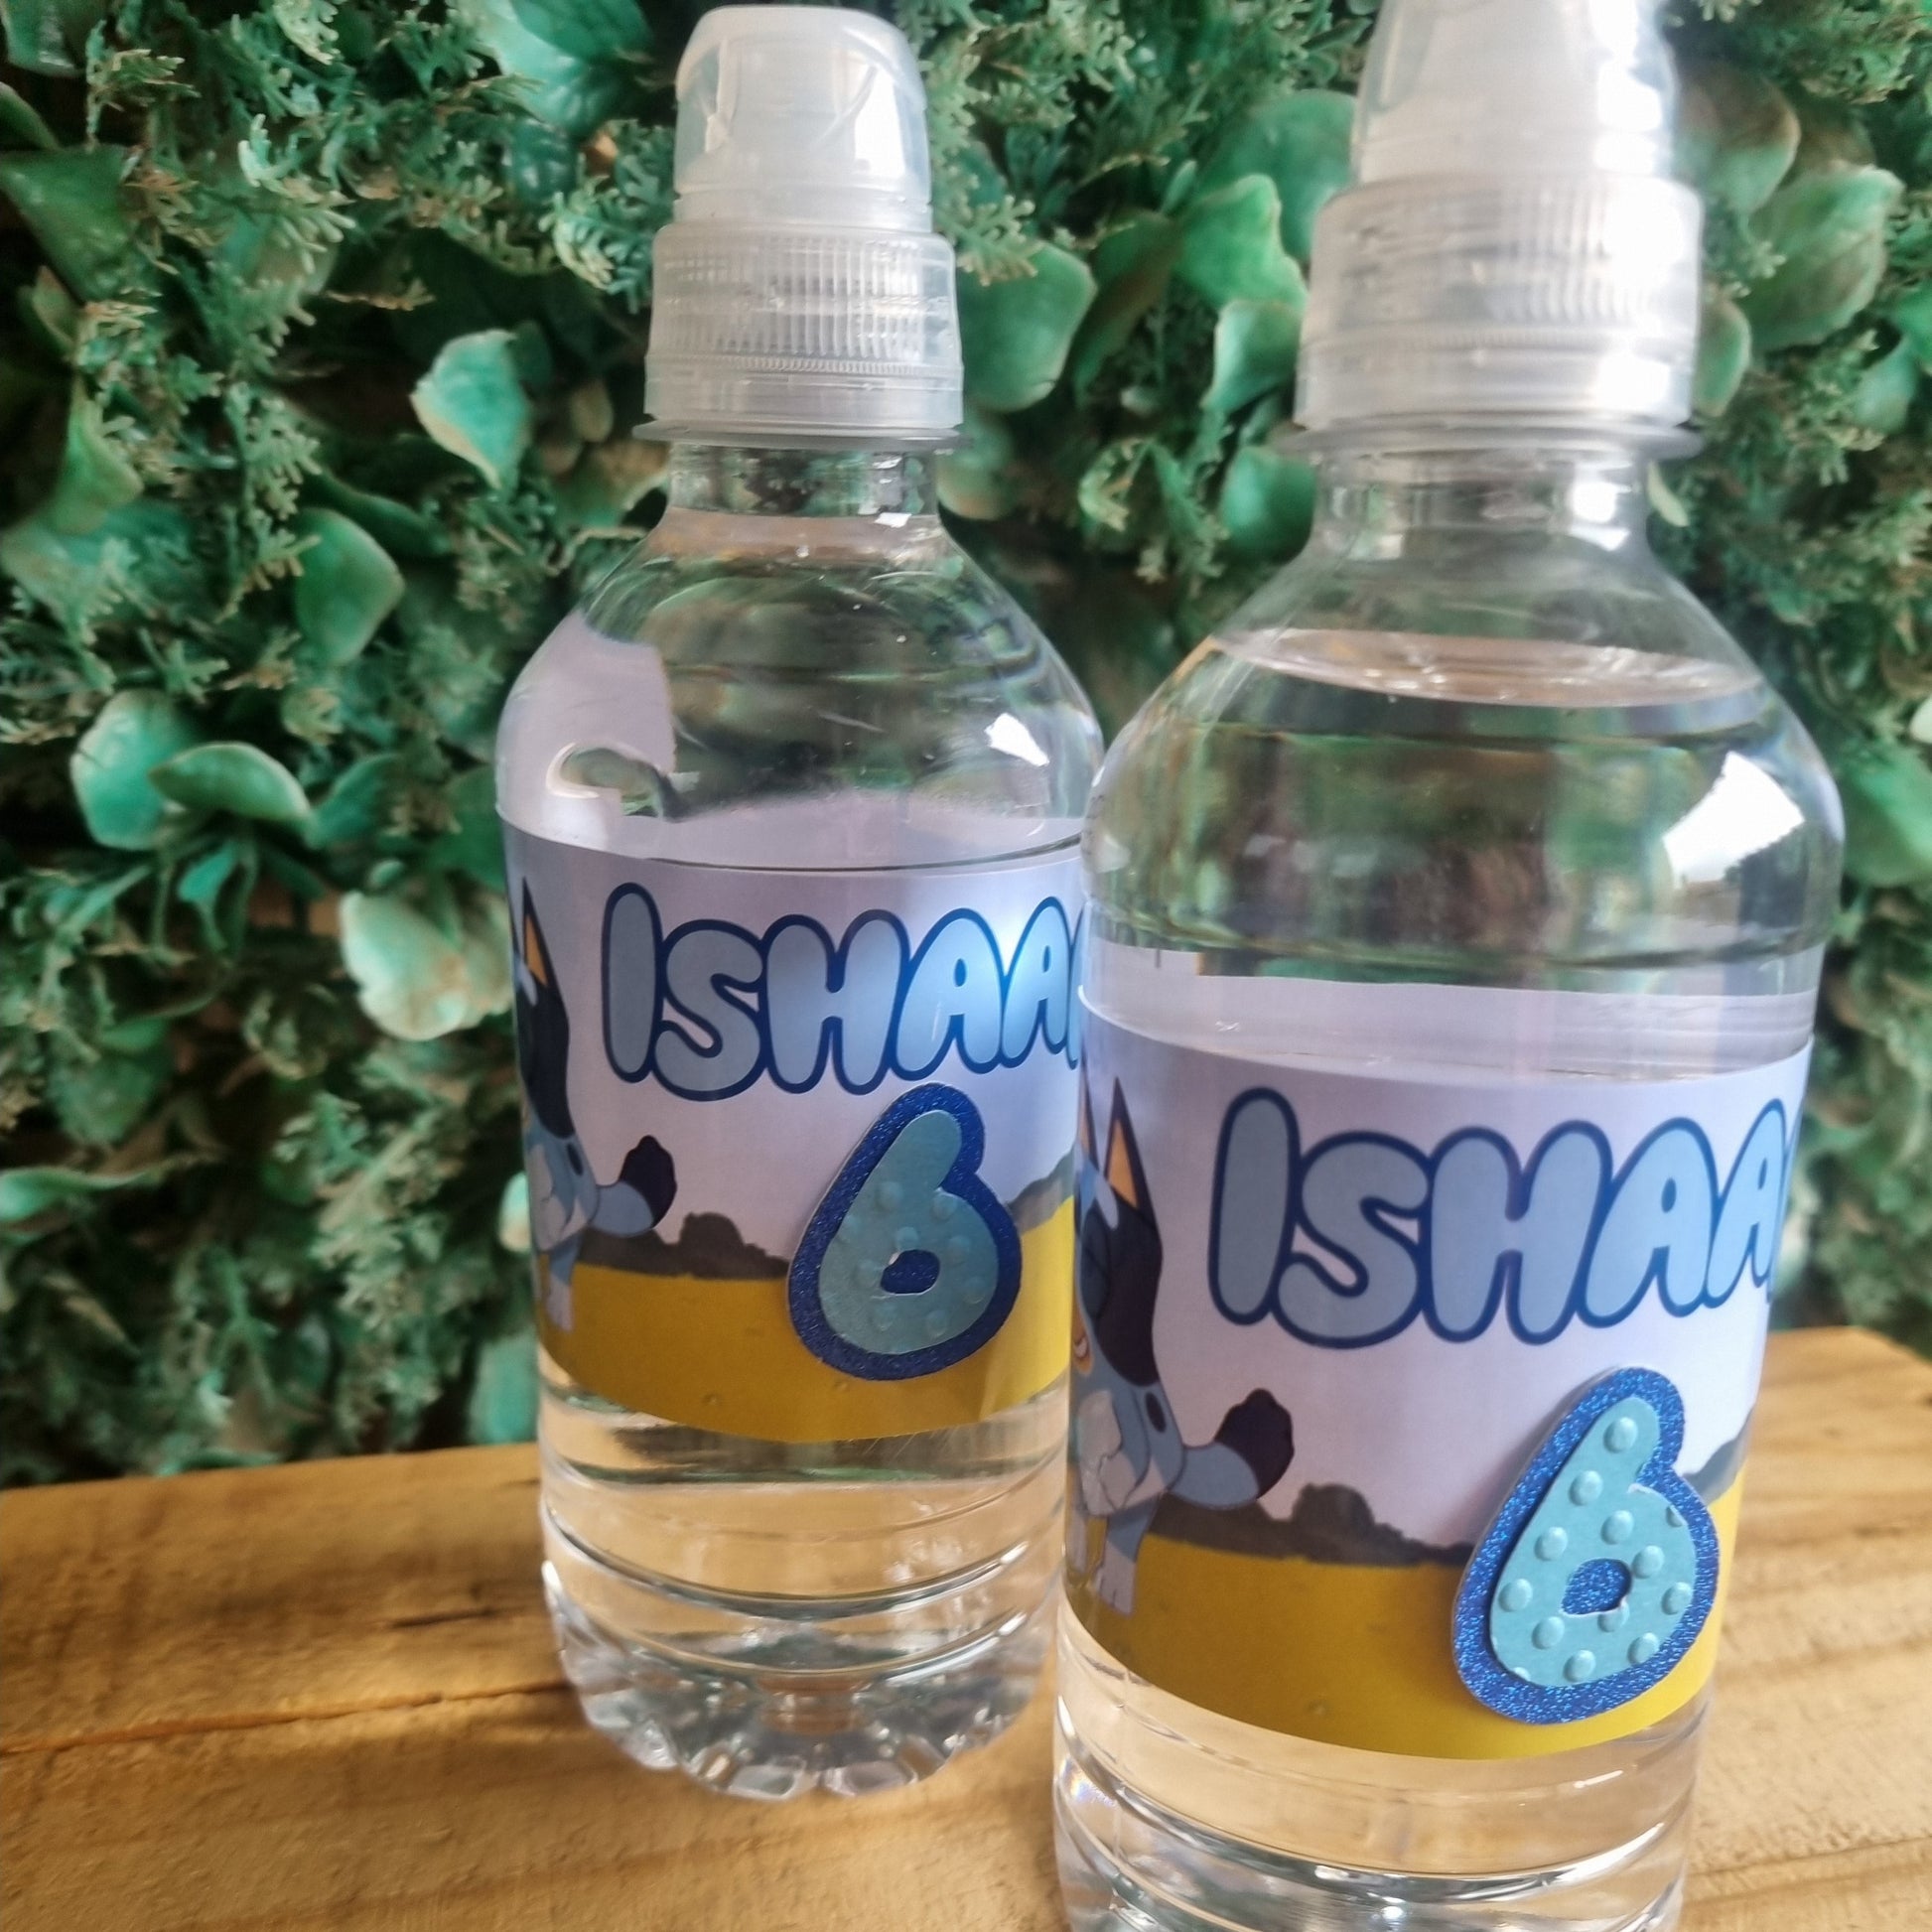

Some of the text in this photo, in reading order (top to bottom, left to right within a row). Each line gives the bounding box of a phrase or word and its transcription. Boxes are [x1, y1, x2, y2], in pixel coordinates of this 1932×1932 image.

[602, 882, 1088, 1102] ISHAA
[788, 1081, 1022, 1381] 6
[1208, 1087, 1802, 1348] ISHAA
[1452, 1366, 1720, 1725] 6
